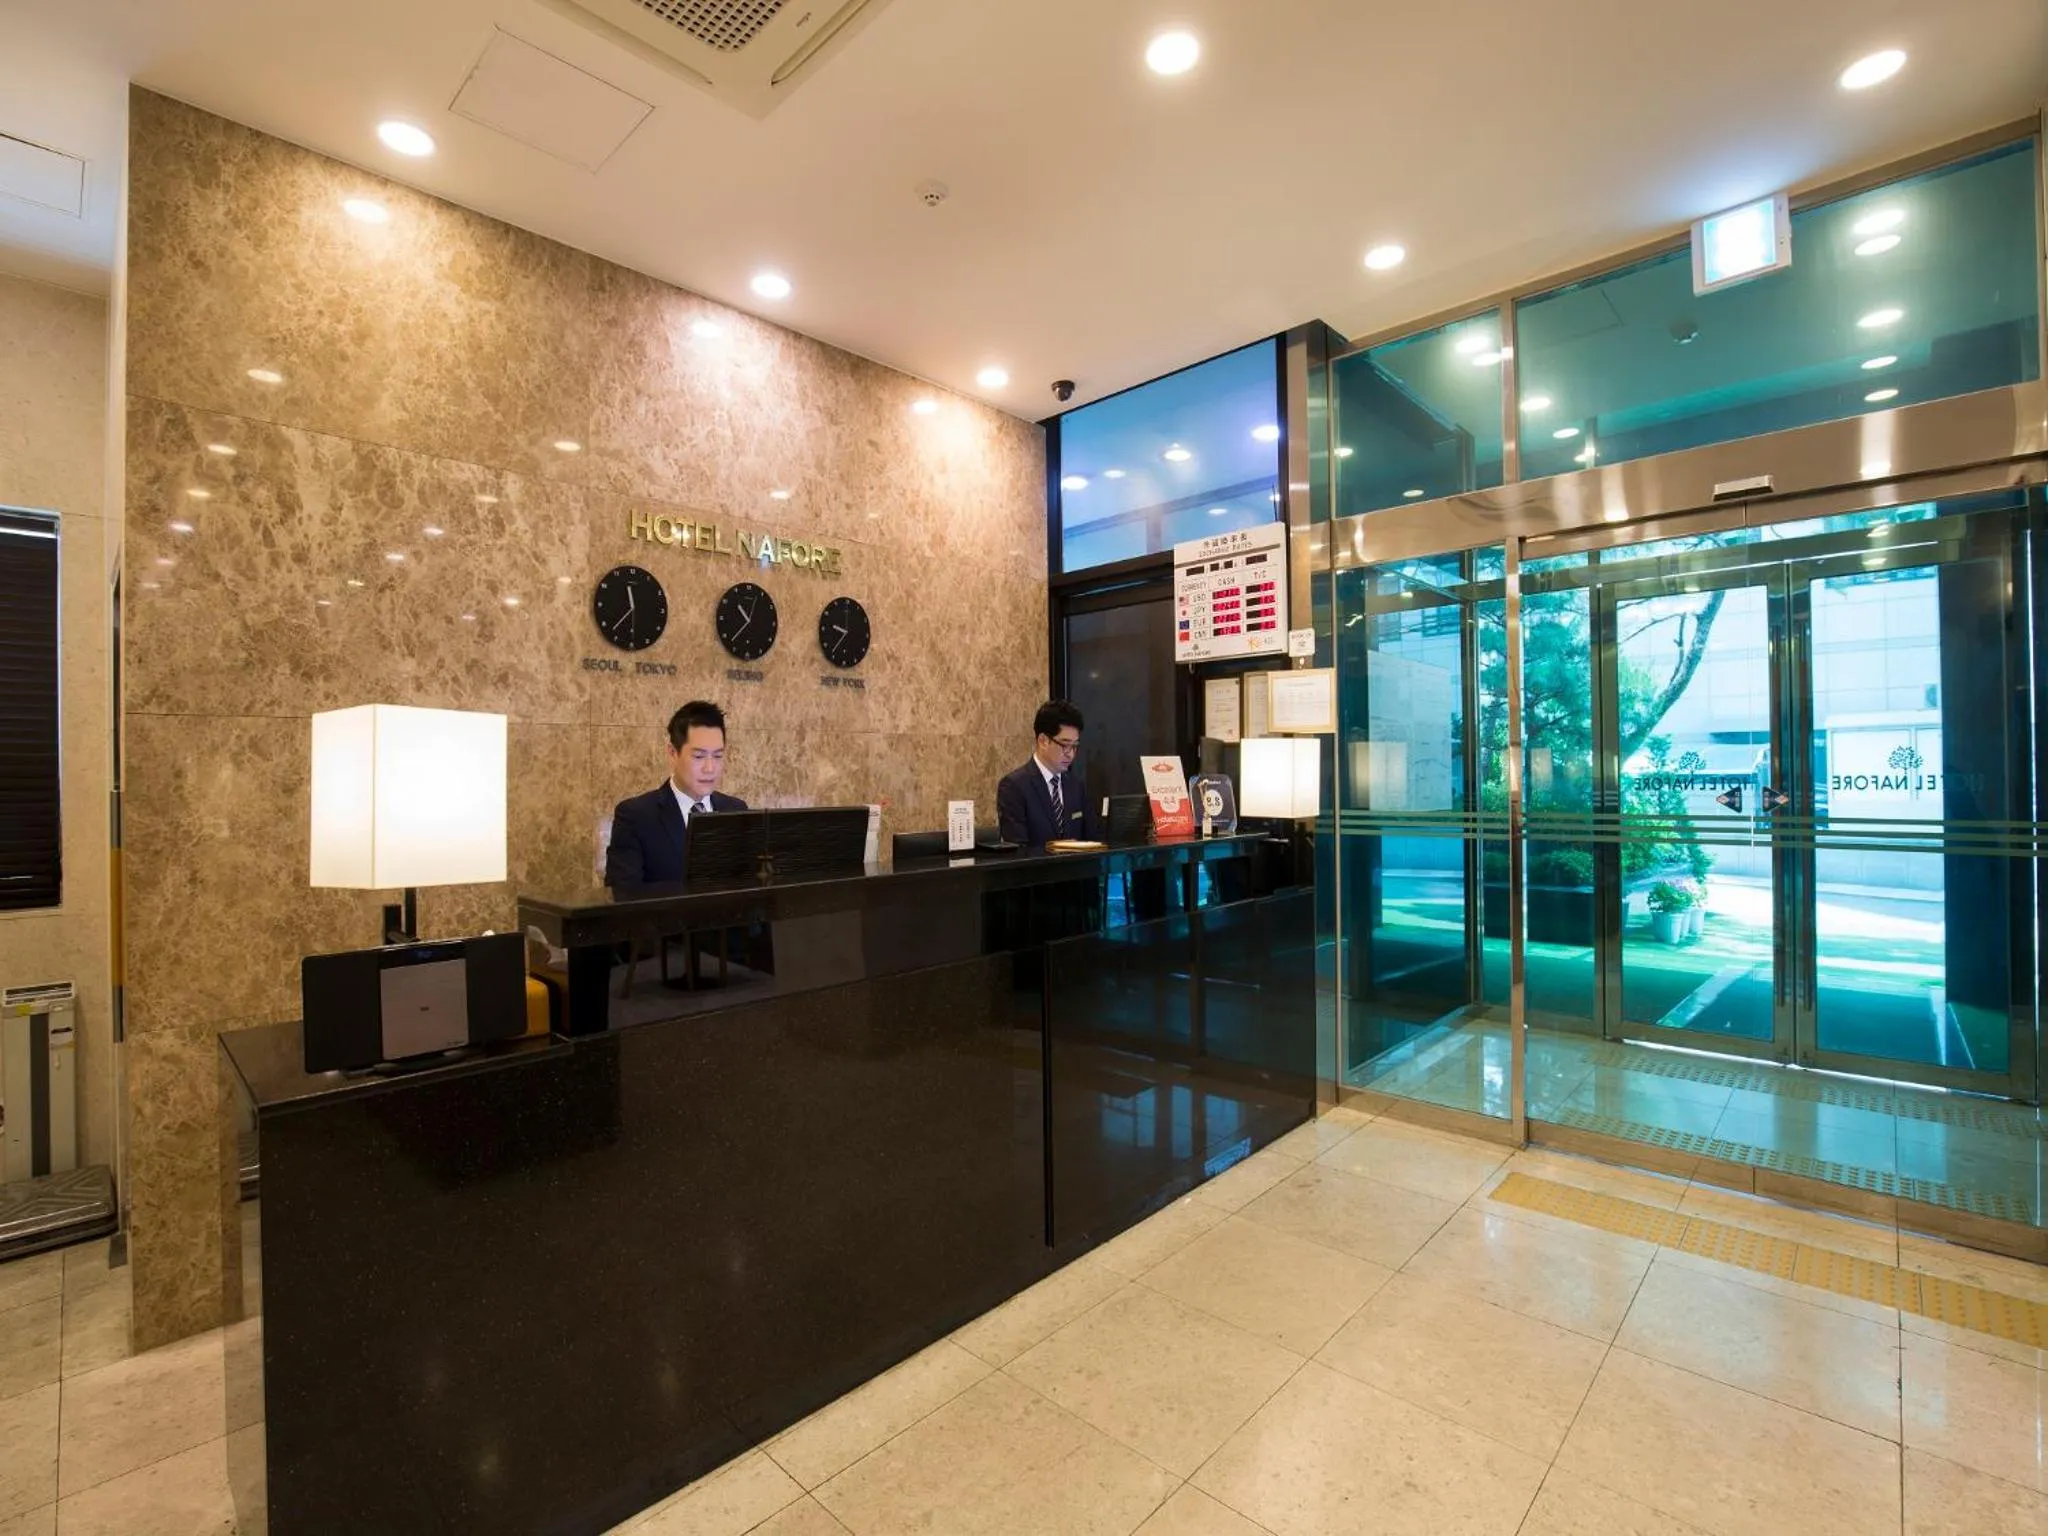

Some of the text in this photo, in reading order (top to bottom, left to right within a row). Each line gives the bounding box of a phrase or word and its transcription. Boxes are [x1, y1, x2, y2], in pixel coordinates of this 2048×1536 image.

[629, 508, 842, 575] HOTEL NAFORE
[1217, 576, 1235, 586] CASH
[582, 658, 677, 676] SEOUL TOKYO
